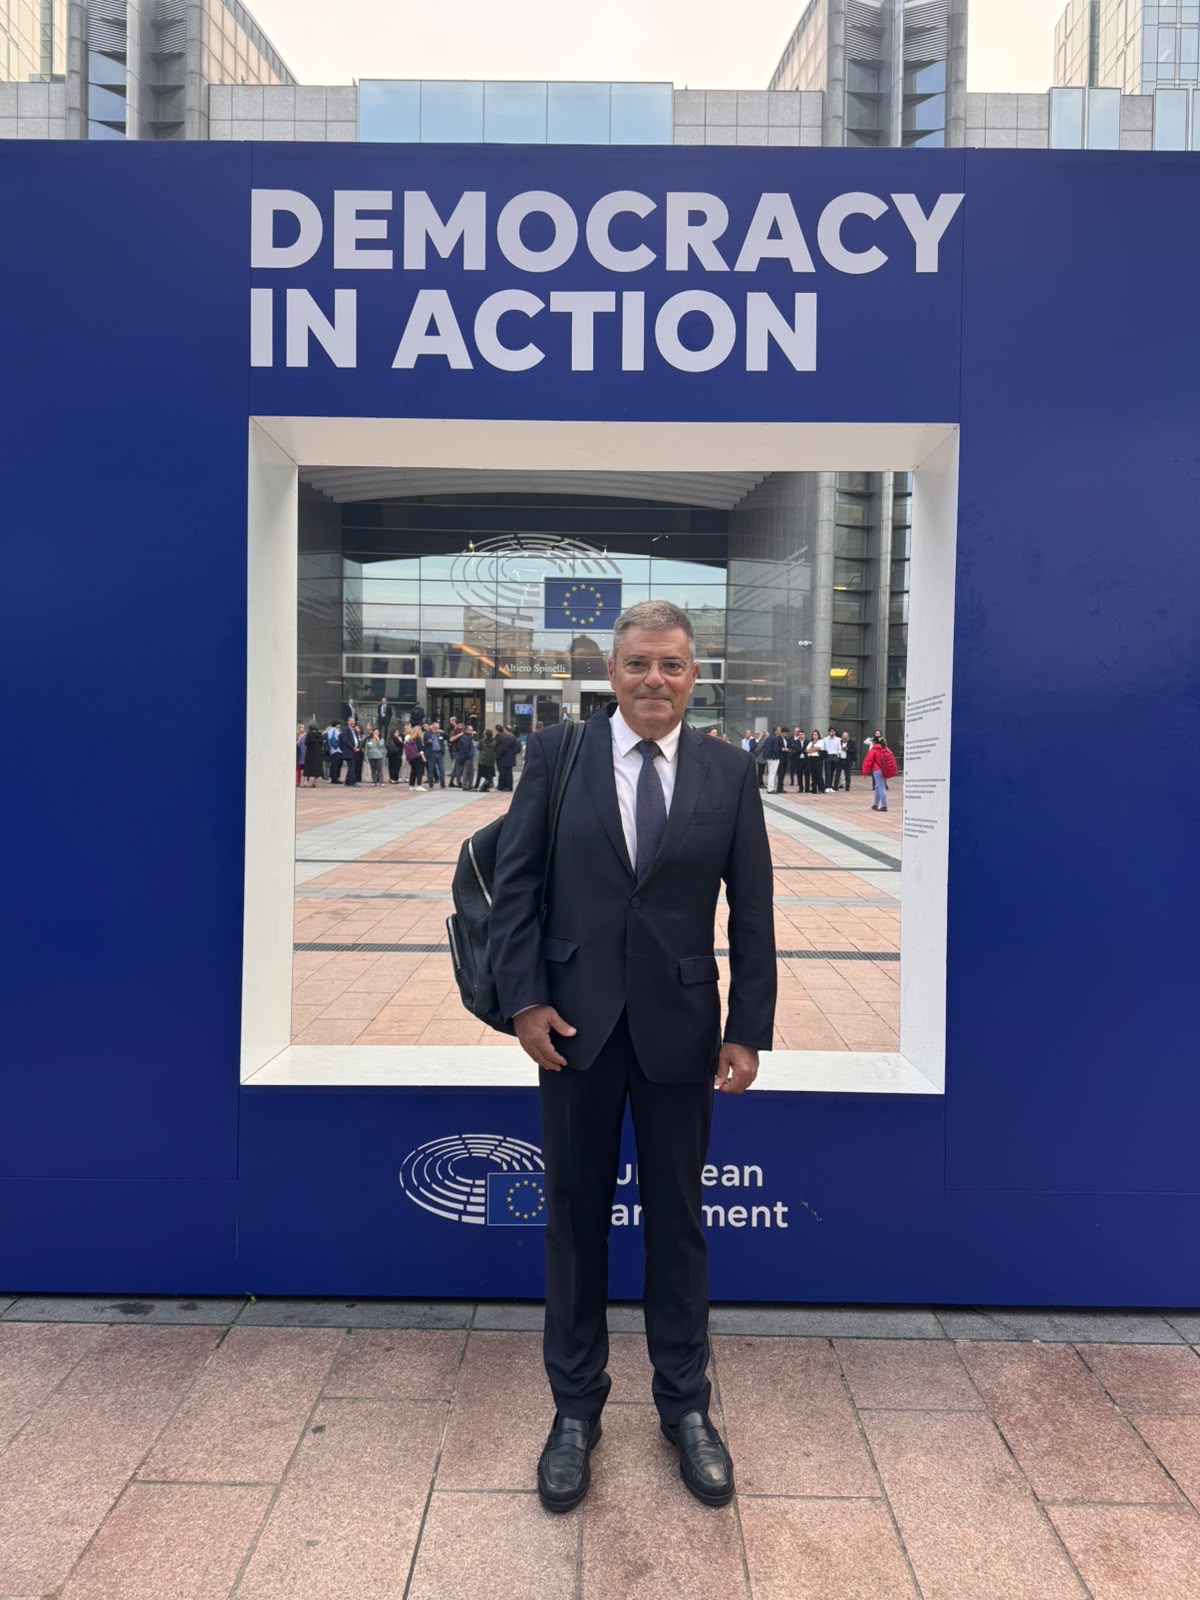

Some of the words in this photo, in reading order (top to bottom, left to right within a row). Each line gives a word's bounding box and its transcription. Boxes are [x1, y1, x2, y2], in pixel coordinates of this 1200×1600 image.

[250, 188, 966, 275] DEMOCRACY
[250, 288, 357, 369] IN
[391, 288, 818, 373] ACTION
[503, 663, 532, 672] Altiero
[533, 663, 566, 675] Spinelli
[611, 1201, 789, 1228] arment
